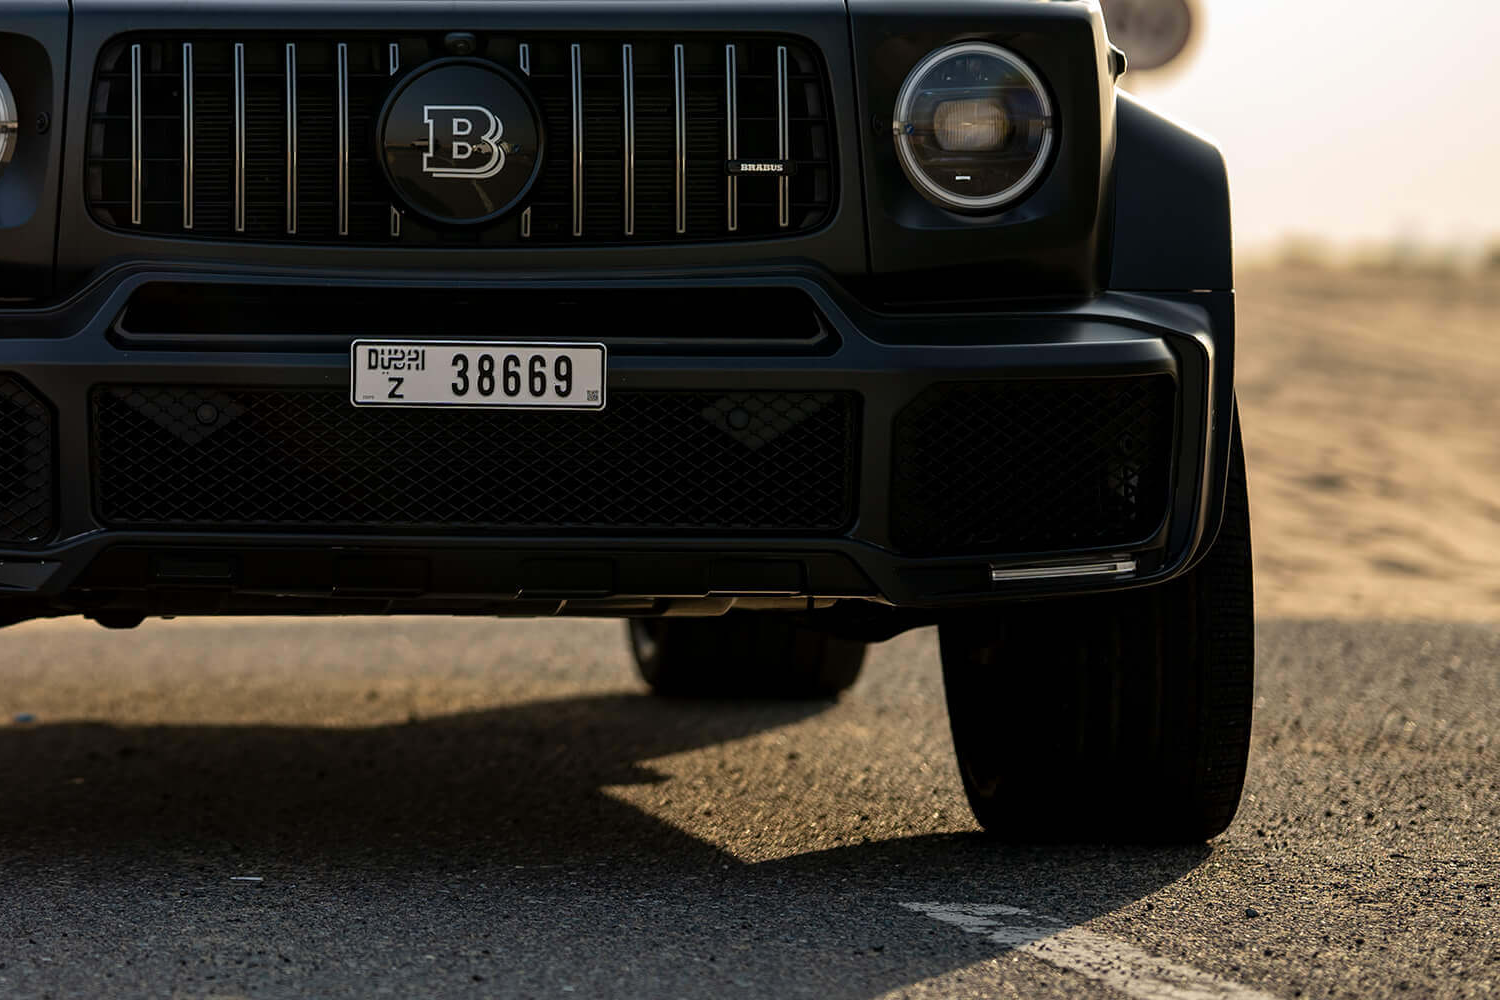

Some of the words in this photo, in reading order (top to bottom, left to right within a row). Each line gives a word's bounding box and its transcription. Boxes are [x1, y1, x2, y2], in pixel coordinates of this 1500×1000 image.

[740, 163, 784, 172] BRABUS
[367, 348, 426, 371] DUBAI
[451, 353, 573, 398] 38669
[387, 377, 405, 399] Z
